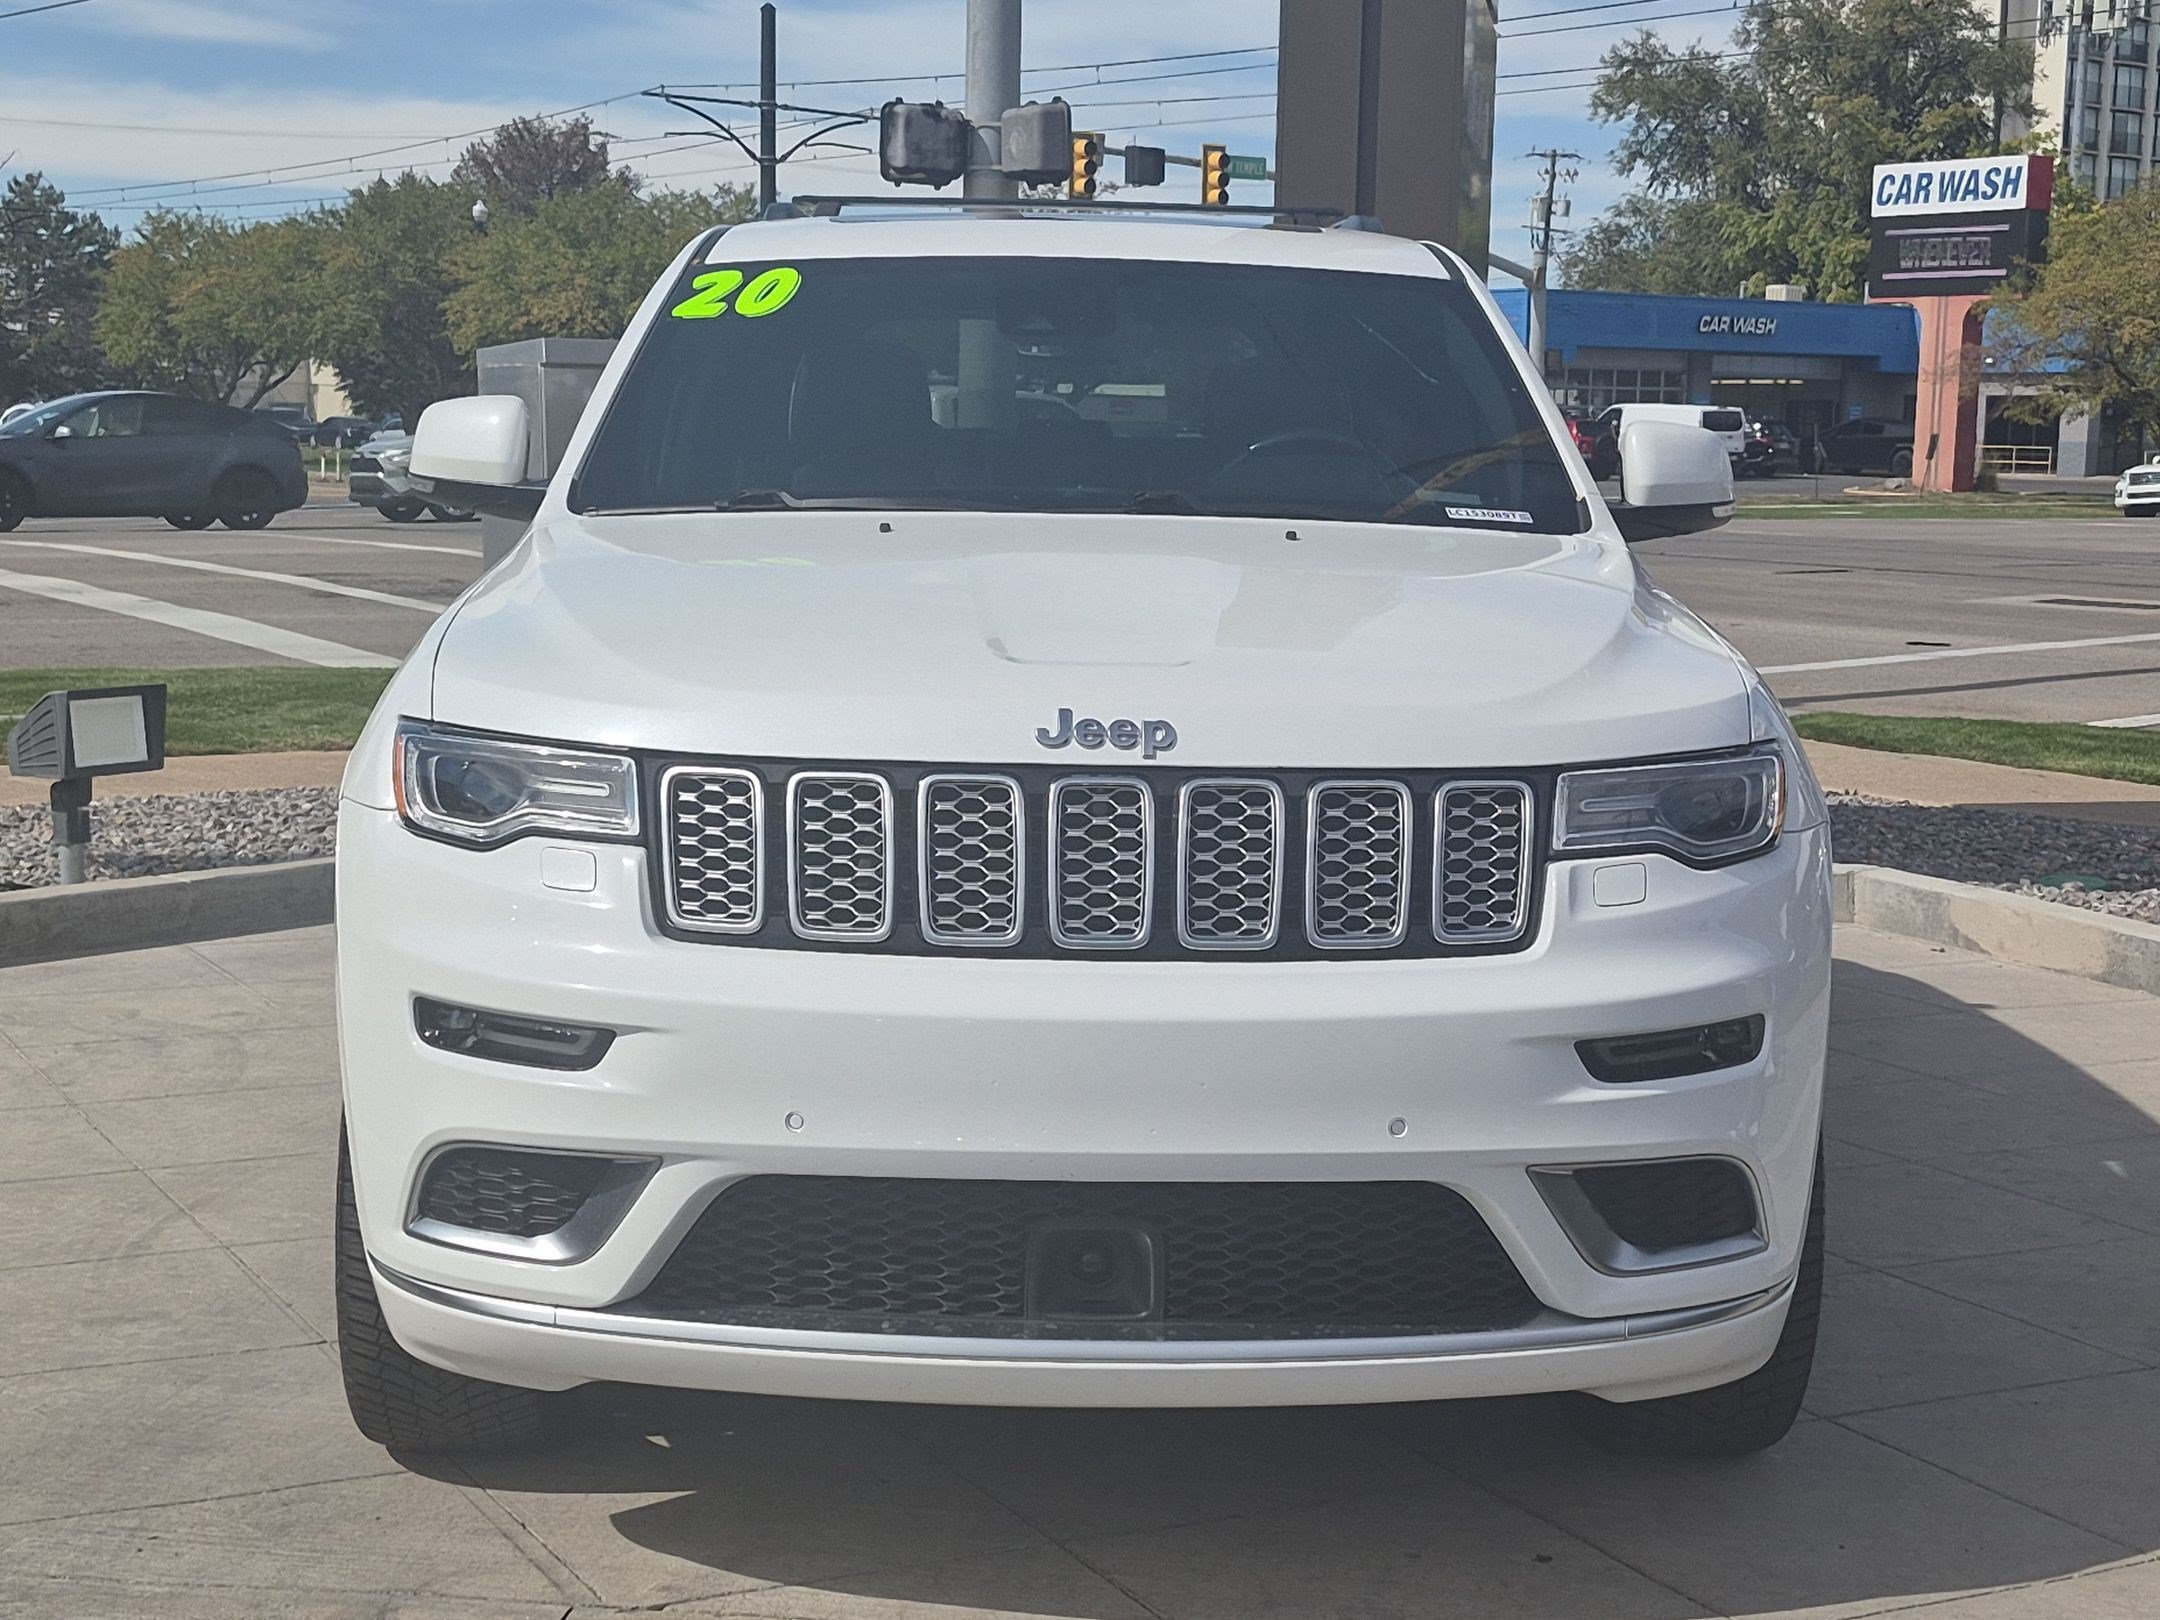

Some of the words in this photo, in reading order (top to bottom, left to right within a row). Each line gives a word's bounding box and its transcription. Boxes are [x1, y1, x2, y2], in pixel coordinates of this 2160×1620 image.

[1876, 172, 1933, 206] CAR
[1938, 166, 2023, 203] WASH
[671, 267, 802, 319] 20
[1699, 315, 1730, 333] CAR
[1732, 317, 1777, 335] WASH
[1035, 707, 1178, 760] Jeep
